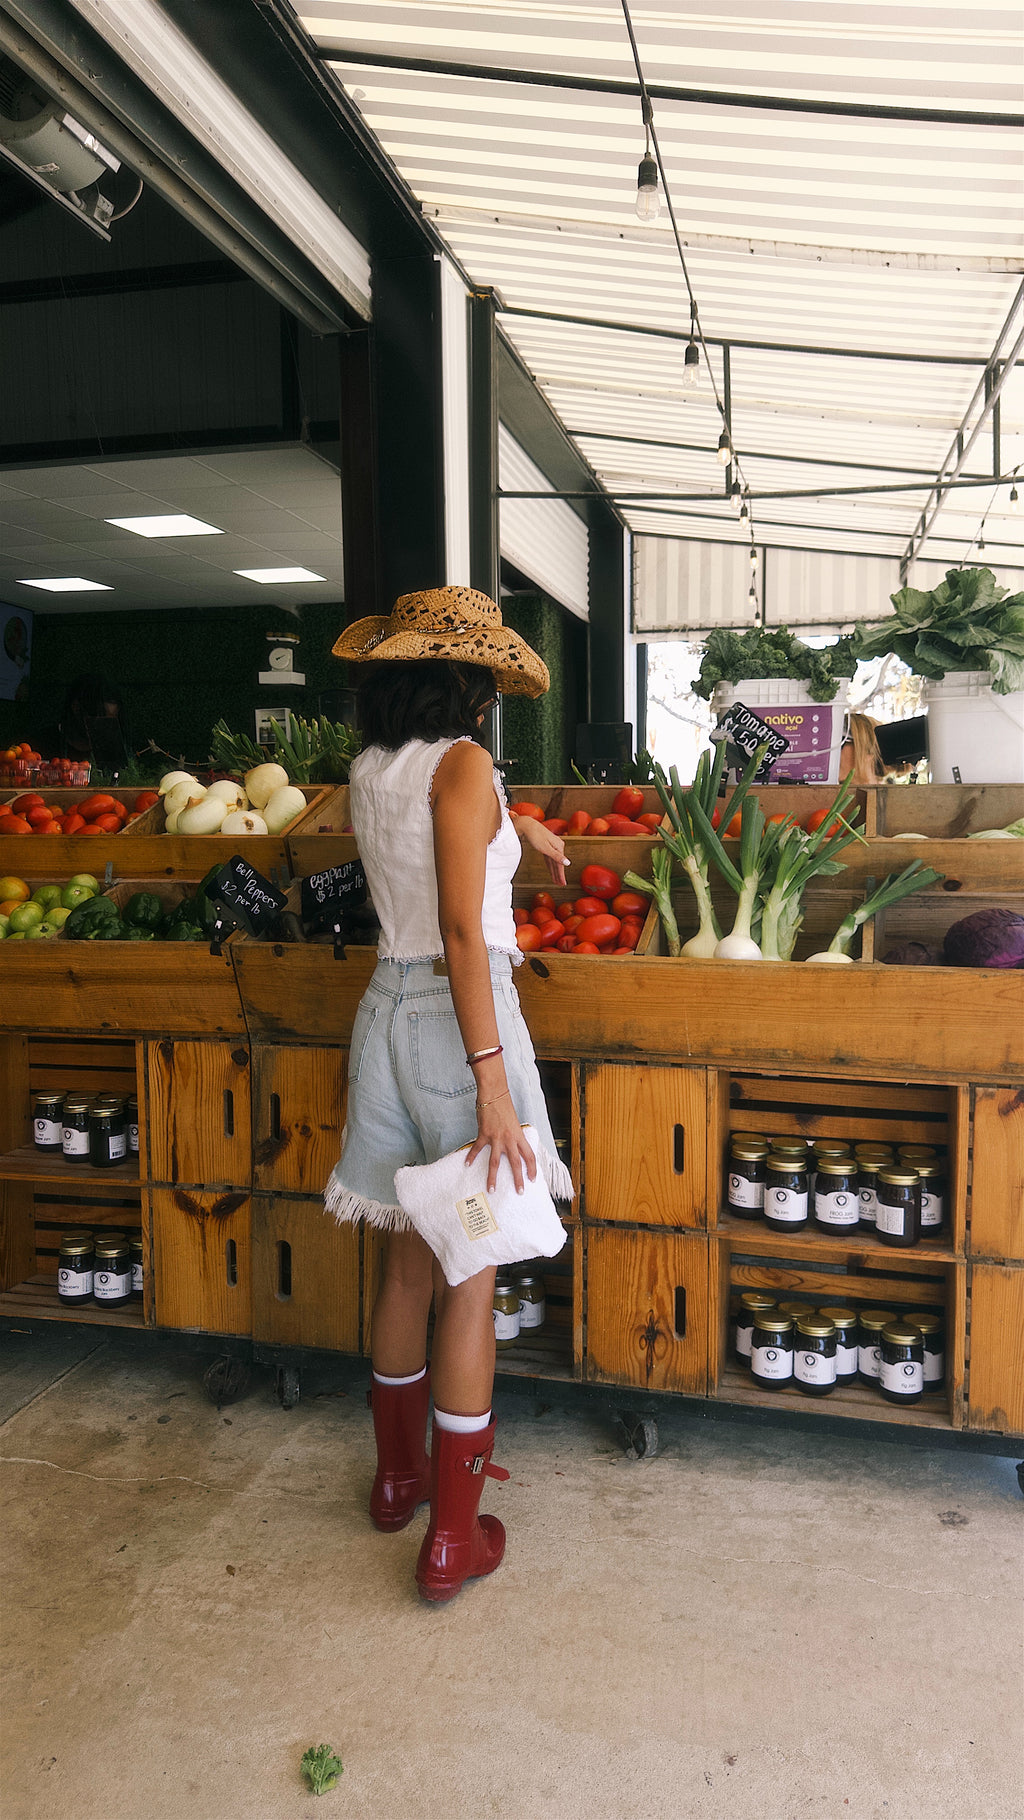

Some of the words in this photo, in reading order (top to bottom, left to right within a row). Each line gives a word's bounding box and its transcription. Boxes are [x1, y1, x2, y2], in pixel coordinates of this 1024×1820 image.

[737, 705, 785, 750] Tomatoe
[764, 713, 804, 725] nativo
[764, 752, 777, 764] er
[235, 863, 254, 880] Bell
[243, 879, 279, 909] Peppers
[338, 881, 354, 897] per
[355, 874, 364, 888] lb
[220, 881, 238, 896] $2
[234, 894, 251, 906] per
[250, 902, 261, 915] lb
